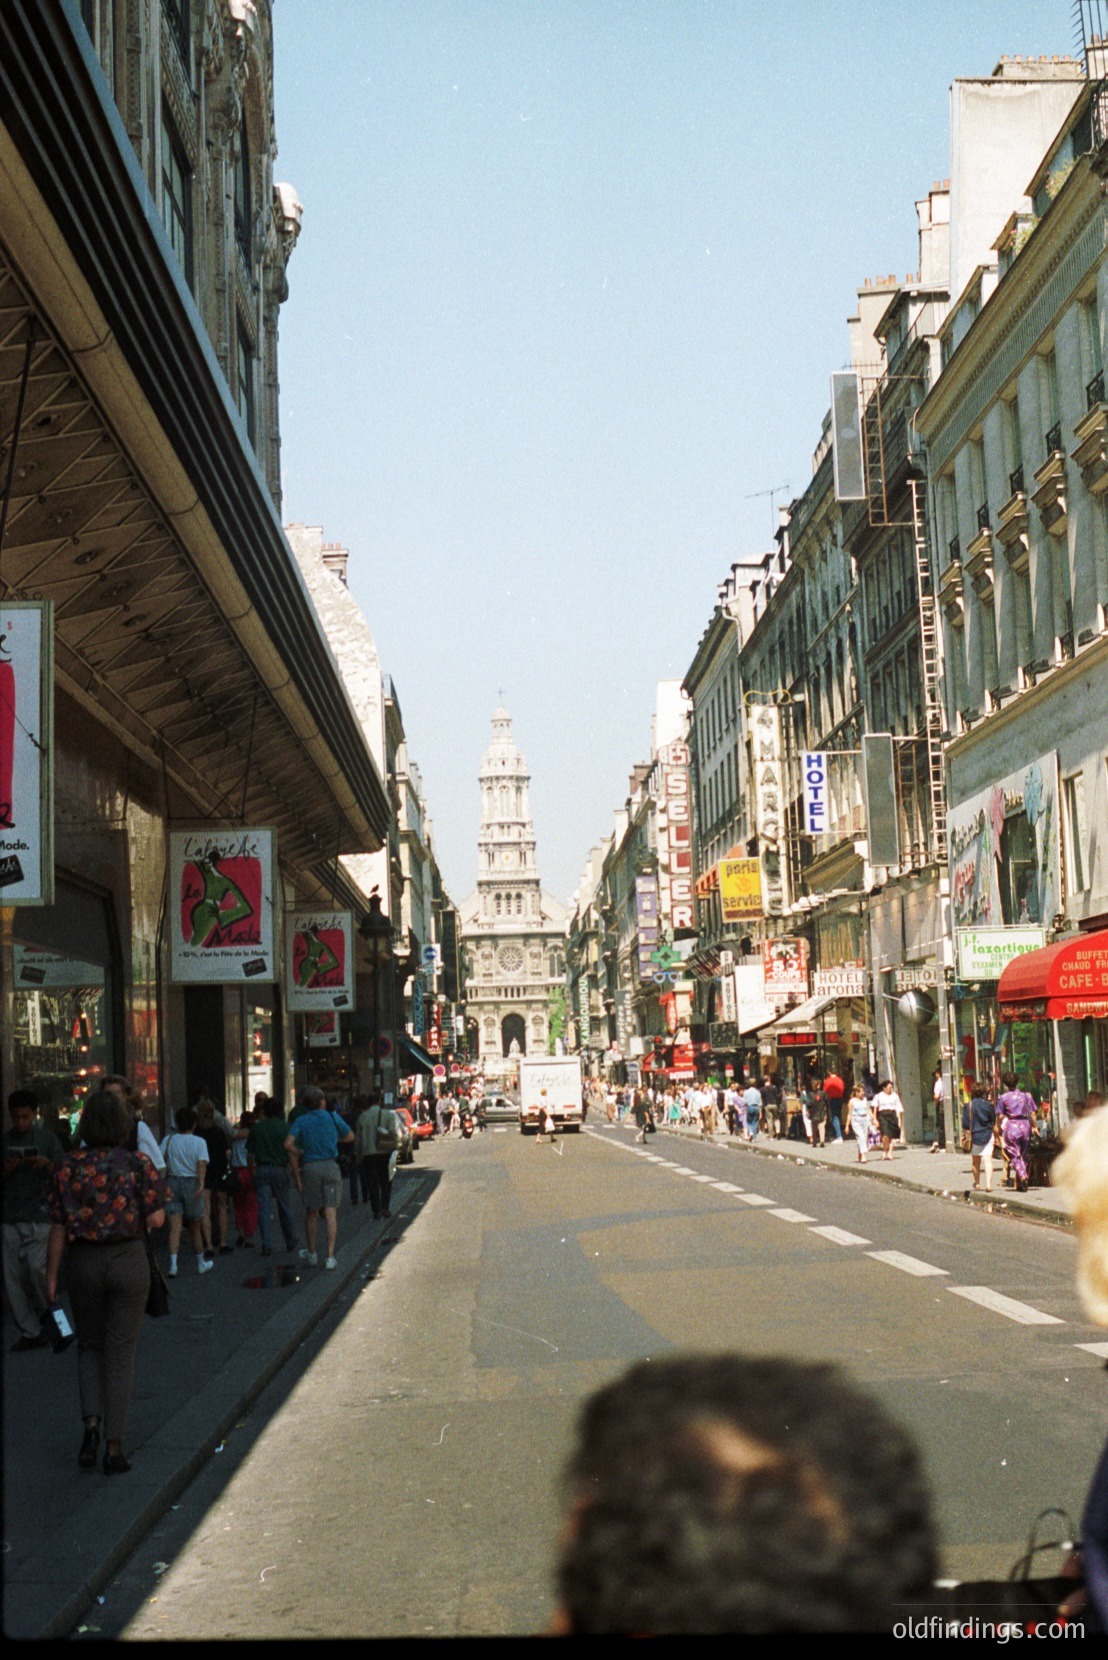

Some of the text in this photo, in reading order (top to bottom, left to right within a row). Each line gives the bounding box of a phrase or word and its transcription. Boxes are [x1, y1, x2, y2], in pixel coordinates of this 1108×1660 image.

[806, 754, 825, 832] HOTEL
[726, 860, 757, 878] paris
[973, 942, 1039, 954] lazartigue
[1062, 960, 1091, 971] CHAUD
[820, 972, 862, 983] HOTEL
[1060, 974, 1093, 989] CAFE
